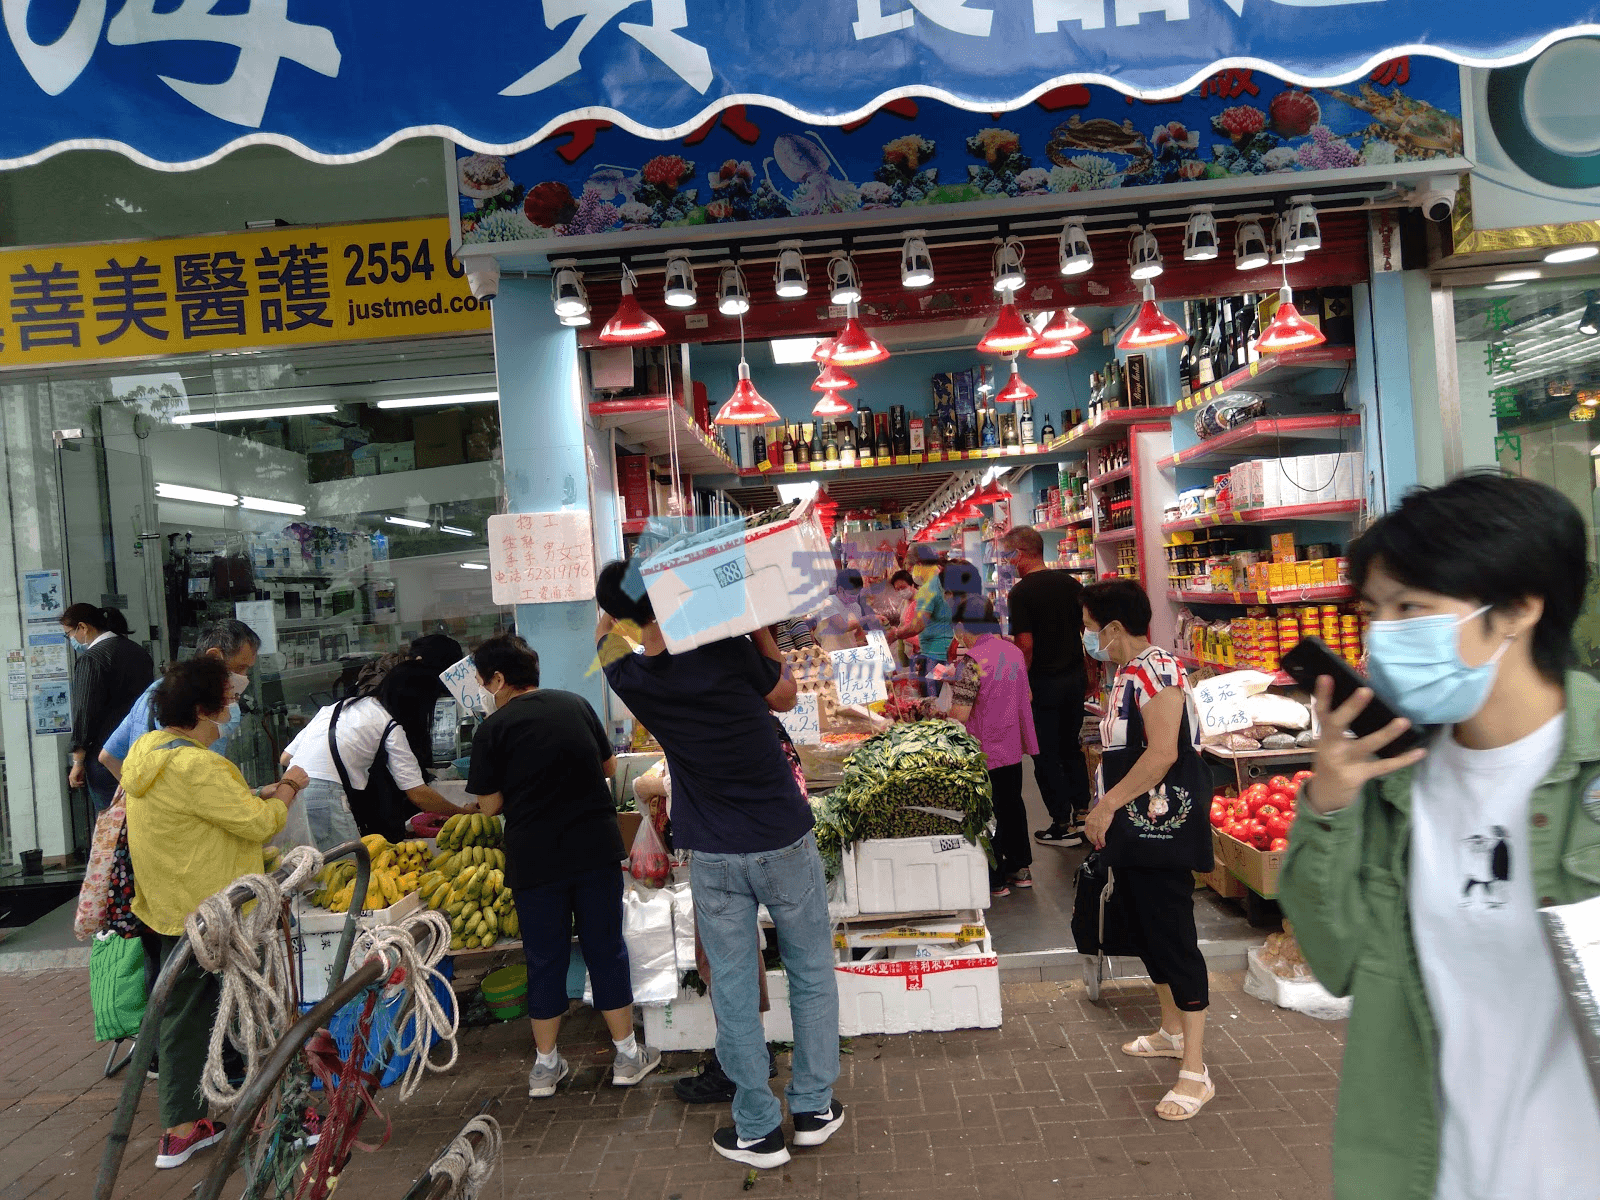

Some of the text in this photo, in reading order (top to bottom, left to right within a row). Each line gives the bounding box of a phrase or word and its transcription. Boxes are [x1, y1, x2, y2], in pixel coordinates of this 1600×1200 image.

[0, 242, 334, 350] 善美醫護
[344, 238, 434, 286] 2554
[1483, 298, 1522, 470] 承接室內
